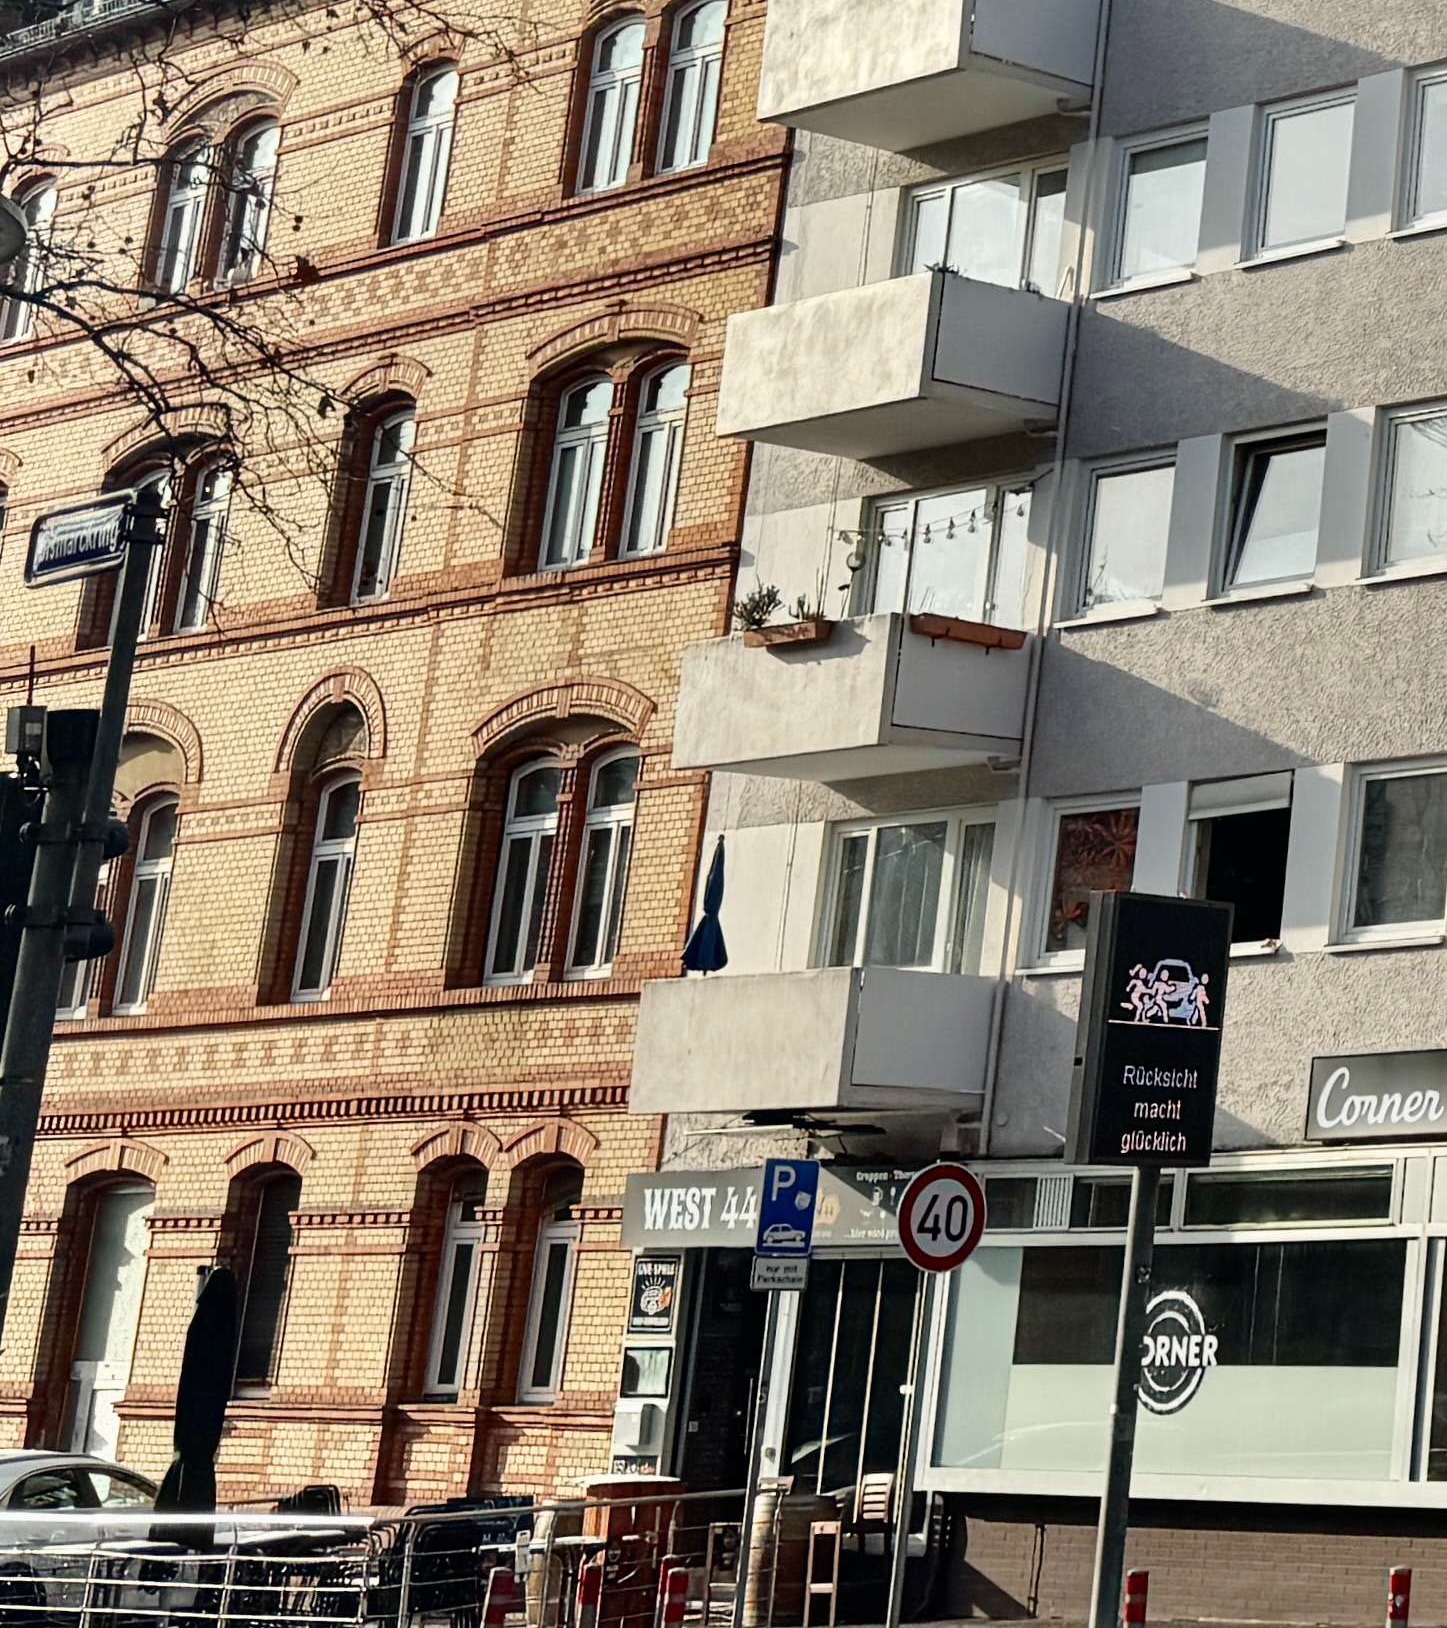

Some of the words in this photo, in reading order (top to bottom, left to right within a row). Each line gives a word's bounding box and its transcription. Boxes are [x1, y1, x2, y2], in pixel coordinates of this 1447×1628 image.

[1122, 1064, 1198, 1089] Rücksicht
[1133, 1099, 1181, 1120] macht
[1316, 1066, 1445, 1129] Corner
[1120, 1130, 1187, 1153] glücklich
[771, 1165, 796, 1201] P
[643, 1187, 716, 1230] WEST
[719, 1186, 758, 1229] 44
[917, 1194, 968, 1242] 40
[1141, 1334, 1219, 1367] ORNER
